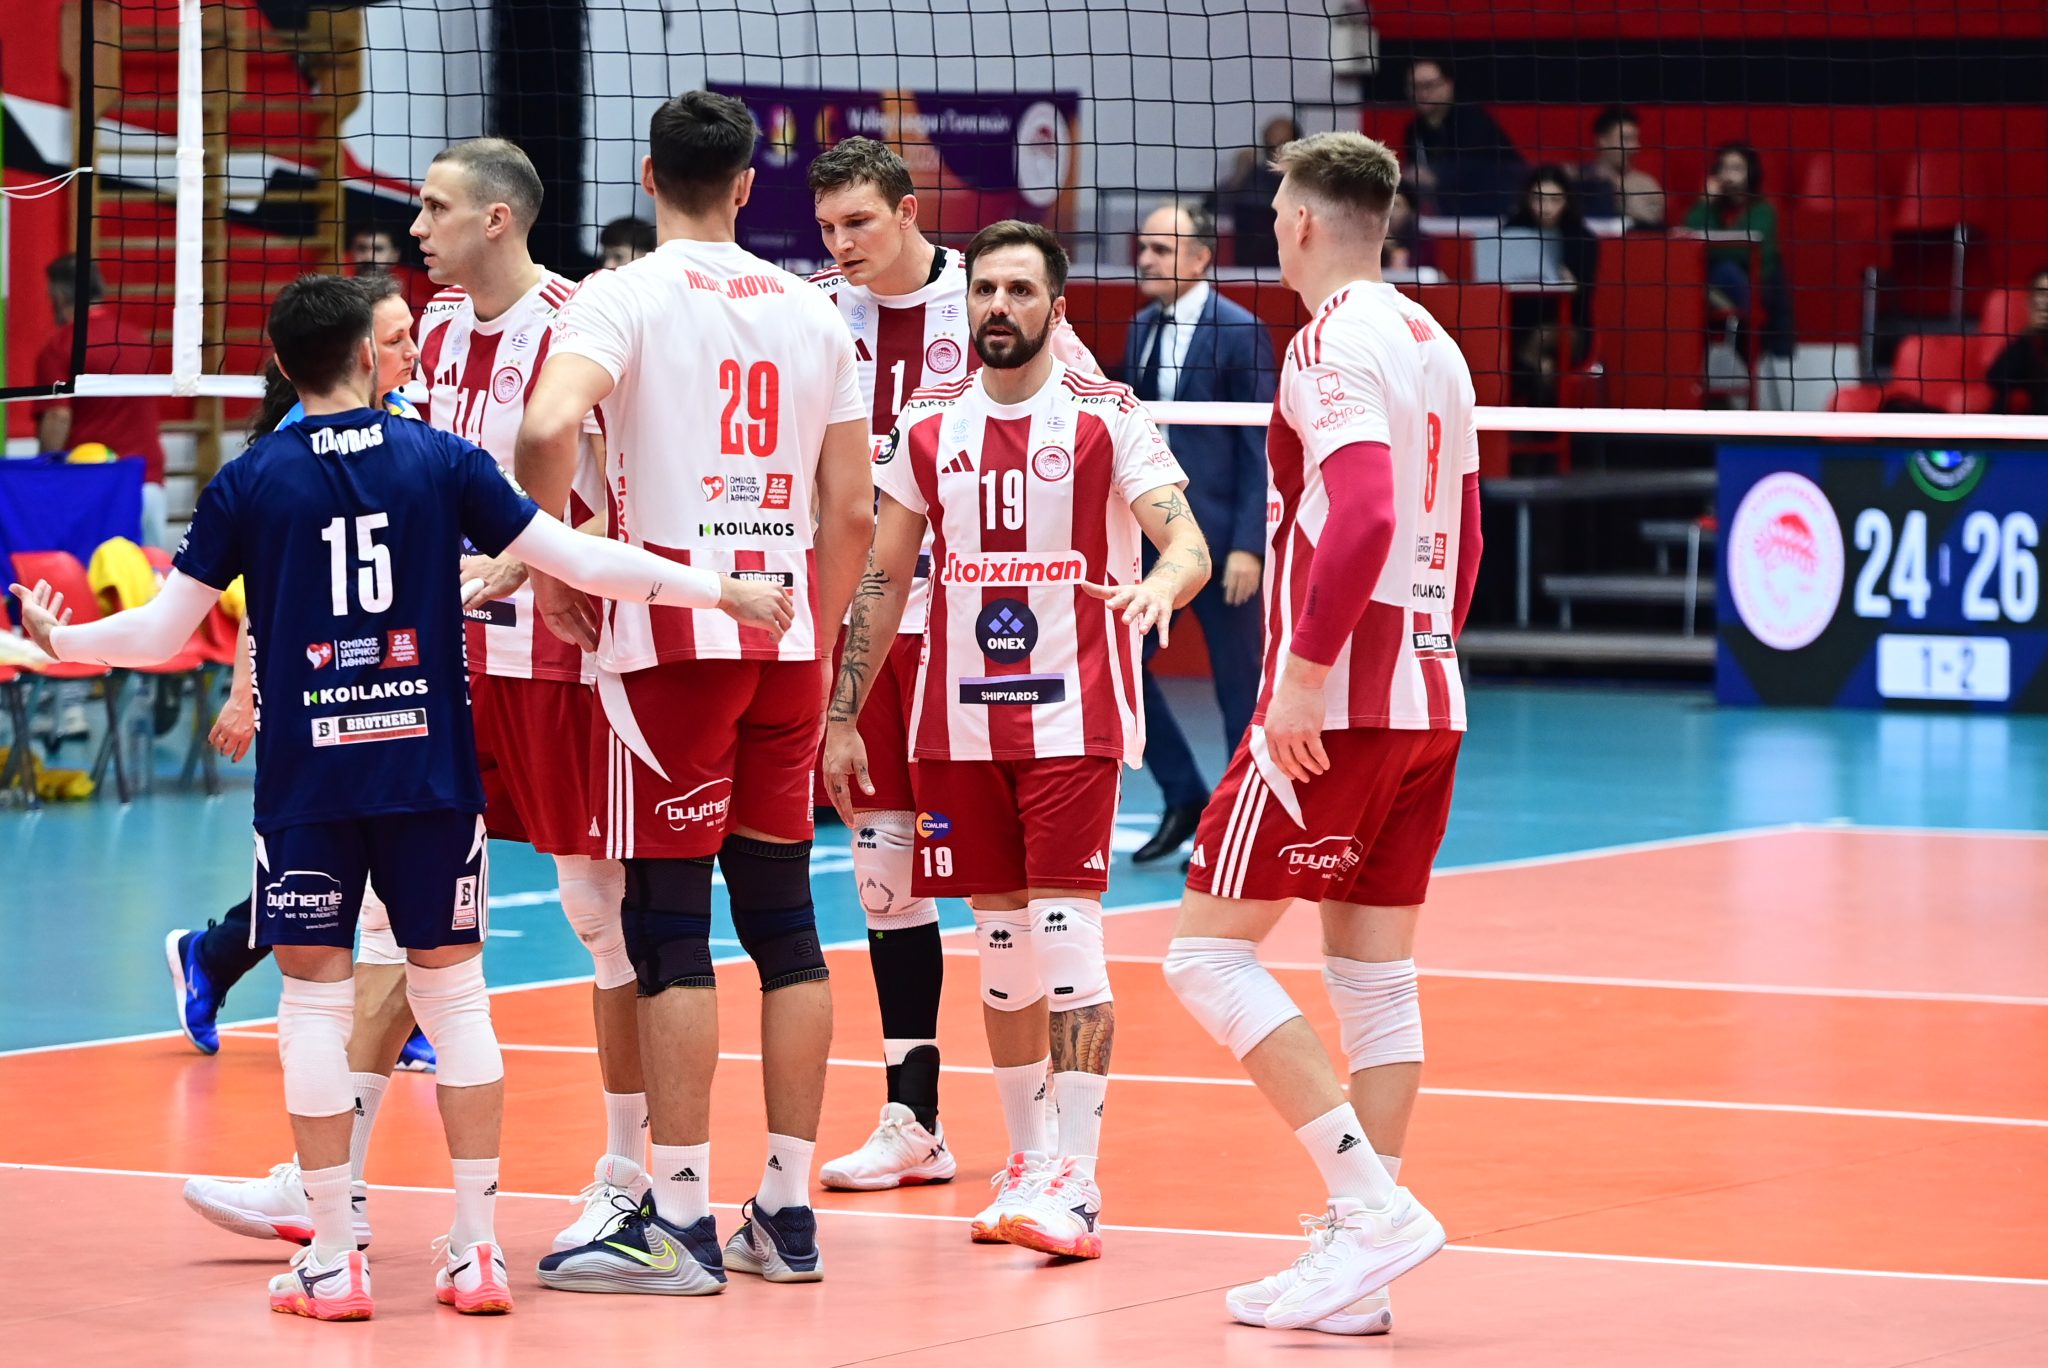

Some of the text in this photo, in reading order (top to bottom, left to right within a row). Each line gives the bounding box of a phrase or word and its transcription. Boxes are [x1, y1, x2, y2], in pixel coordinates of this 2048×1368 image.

[684, 269, 785, 299] NEDJKOVIC
[891, 359, 906, 416] 1
[456, 387, 488, 448] 14
[719, 359, 779, 458] 29
[1311, 404, 1366, 432] VECHRO
[771, 477, 786, 488] 22
[981, 468, 1024, 531] 19
[714, 522, 795, 536] KOILAKOS
[1436, 537, 1444, 548] 22
[321, 511, 393, 617] 15
[944, 552, 1082, 583] Stoiximan
[1853, 507, 1932, 620] 24
[1961, 510, 2040, 623] 26
[340, 637, 379, 649] ΟΜΙΛΟΣ
[393, 634, 411, 646] 22
[987, 638, 1026, 650] ONEX
[320, 679, 429, 705] KOILAKOS
[981, 691, 1039, 701] SHIPYARDS
[346, 712, 417, 731] BROTHERS
[920, 846, 953, 878] 19
[1337, 1138, 1362, 1154] adidas
